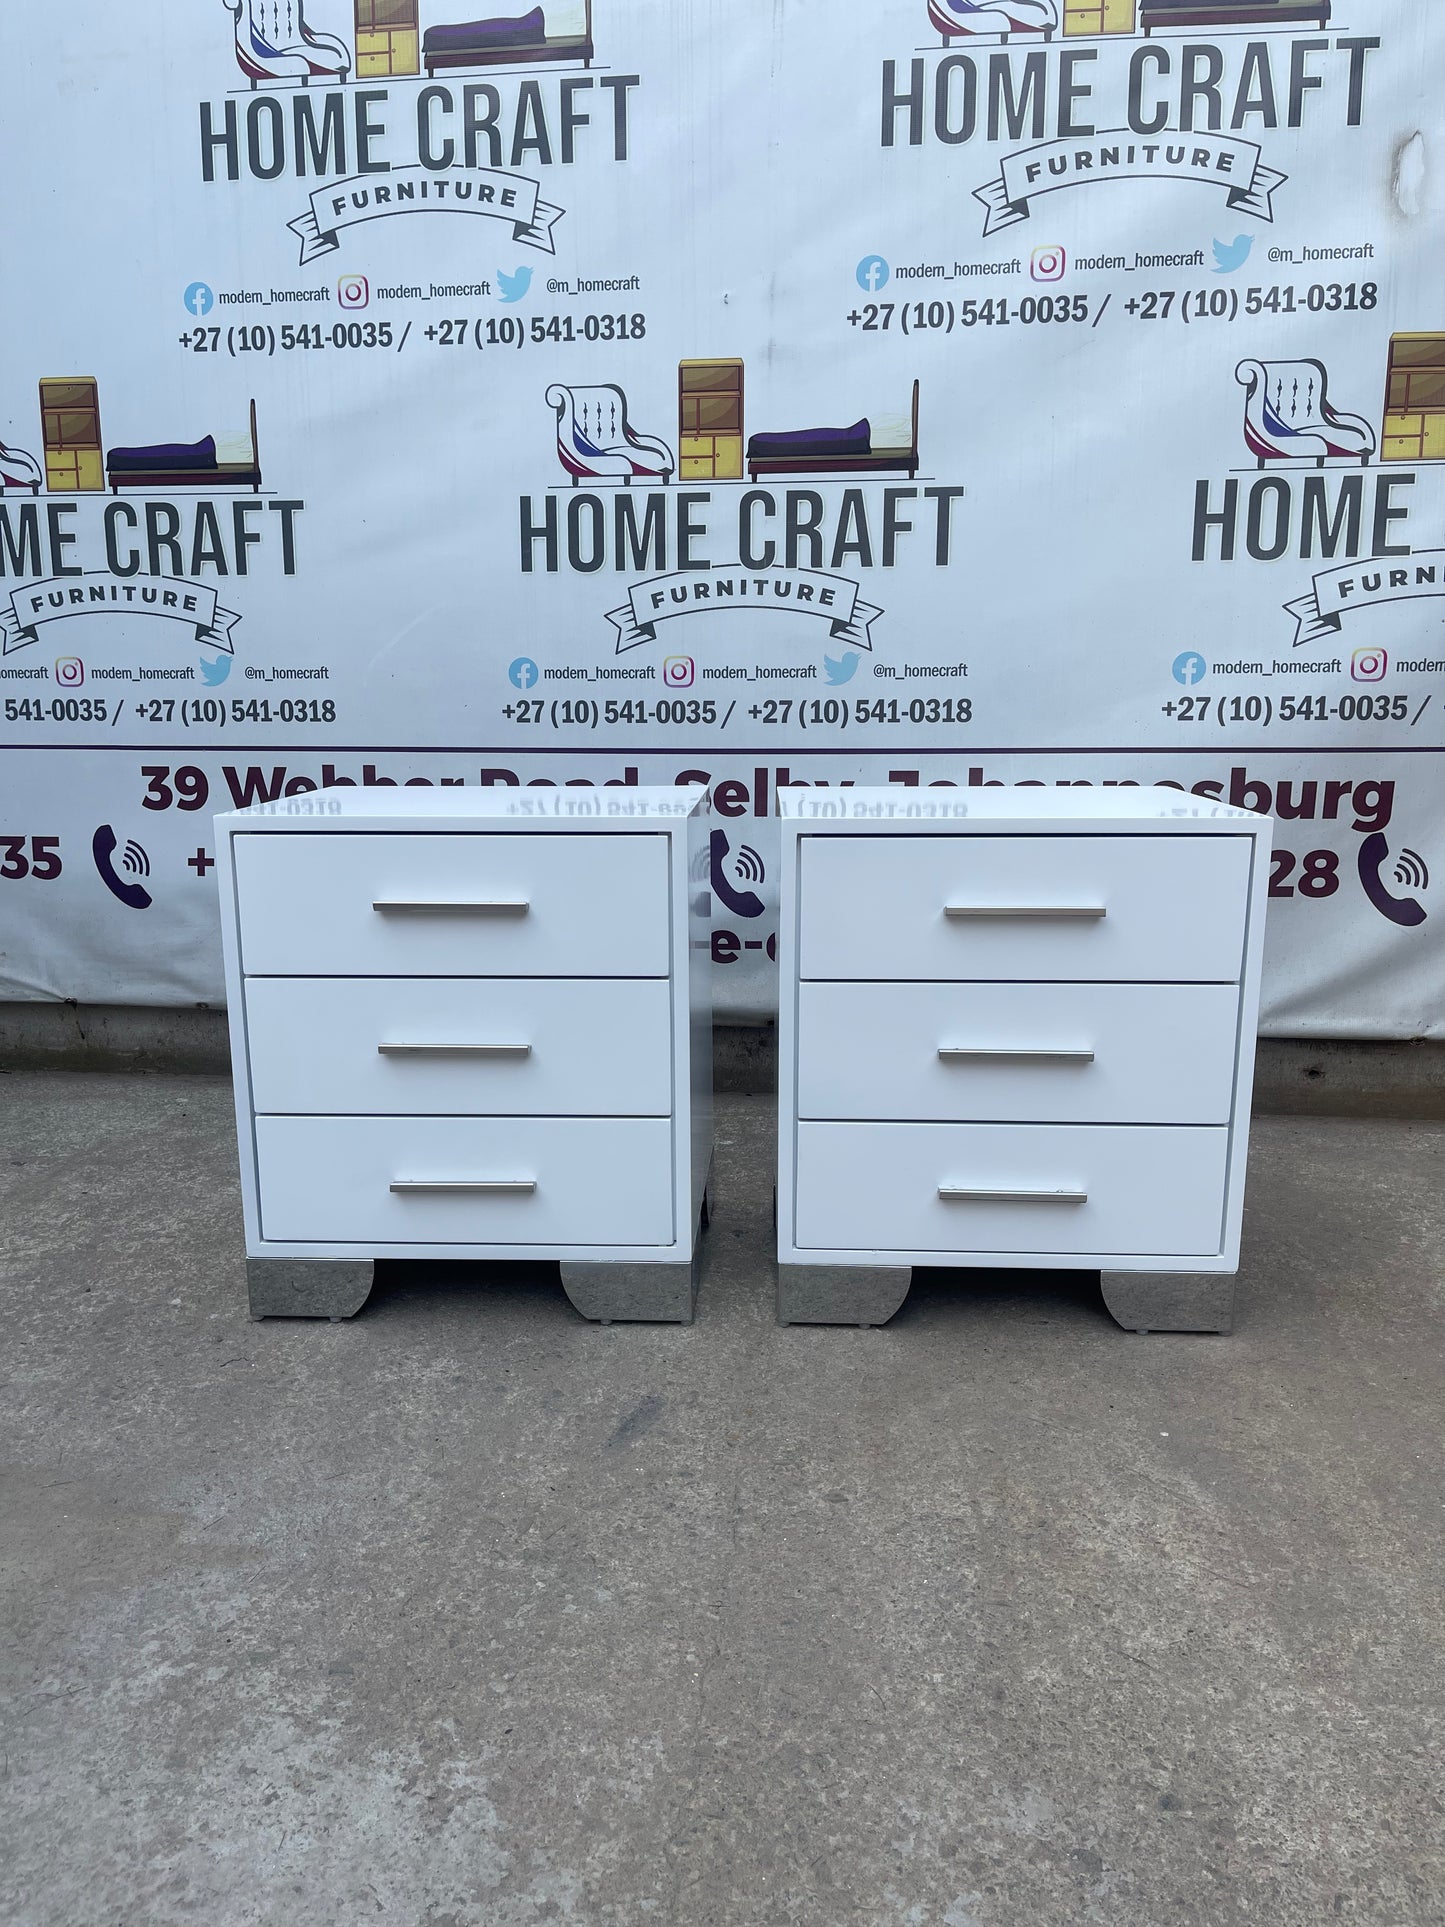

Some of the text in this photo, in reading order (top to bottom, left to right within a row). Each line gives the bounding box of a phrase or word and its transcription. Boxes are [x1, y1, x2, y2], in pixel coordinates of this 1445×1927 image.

[881, 37, 1381, 147] HOME CRAFT
[200, 75, 640, 182] HOME CRAFT
[1026, 146, 1235, 183] FURNITURE
[332, 181, 516, 216] FURNITURE
[896, 243, 1374, 280] modern_homecraft modern_homecraft @m_homecraft
[219, 275, 640, 305] modern_homecraft modern_homecraft @m_homecraft
[847, 304, 894, 330] +27
[901, 301, 954, 335] (10)
[961, 295, 1088, 326] 541-0035
[1124, 292, 1175, 319] +27
[1182, 289, 1238, 323] (10)
[1245, 282, 1377, 314] 541-0318
[179, 327, 220, 352] +27
[228, 326, 275, 357] (10)
[281, 322, 392, 350] 541-0035
[424, 319, 468, 345] +27
[475, 318, 524, 350] (10)
[531, 313, 645, 342] 541-0318
[520, 486, 964, 572] HOME CRAFT
[1192, 473, 1415, 561] HOME
[104, 500, 304, 577] CRAFT
[31, 586, 197, 613] FURNITURE
[651, 580, 835, 609] FURNITURE
[0, 666, 329, 681] omecraft modern_homecraft @m_homecraft
[544, 663, 968, 681] modern_homecraft modern_homecraft @m_homecraft
[1213, 659, 1341, 676] modern_homecraft
[5, 699, 107, 721] 541-0035
[136, 700, 175, 721] +27
[182, 700, 226, 727] (10)
[232, 699, 336, 722] 541-0318
[502, 700, 544, 723] +27
[551, 700, 598, 729] (10)
[605, 700, 716, 724] 541-0035
[748, 700, 792, 723] +27
[799, 700, 848, 729] (10)
[855, 699, 972, 723] 541-0318
[1162, 697, 1211, 721] +27
[1218, 696, 1272, 726] (10)
[1279, 695, 1408, 721] 541-0035
[141, 766, 208, 811] 39
